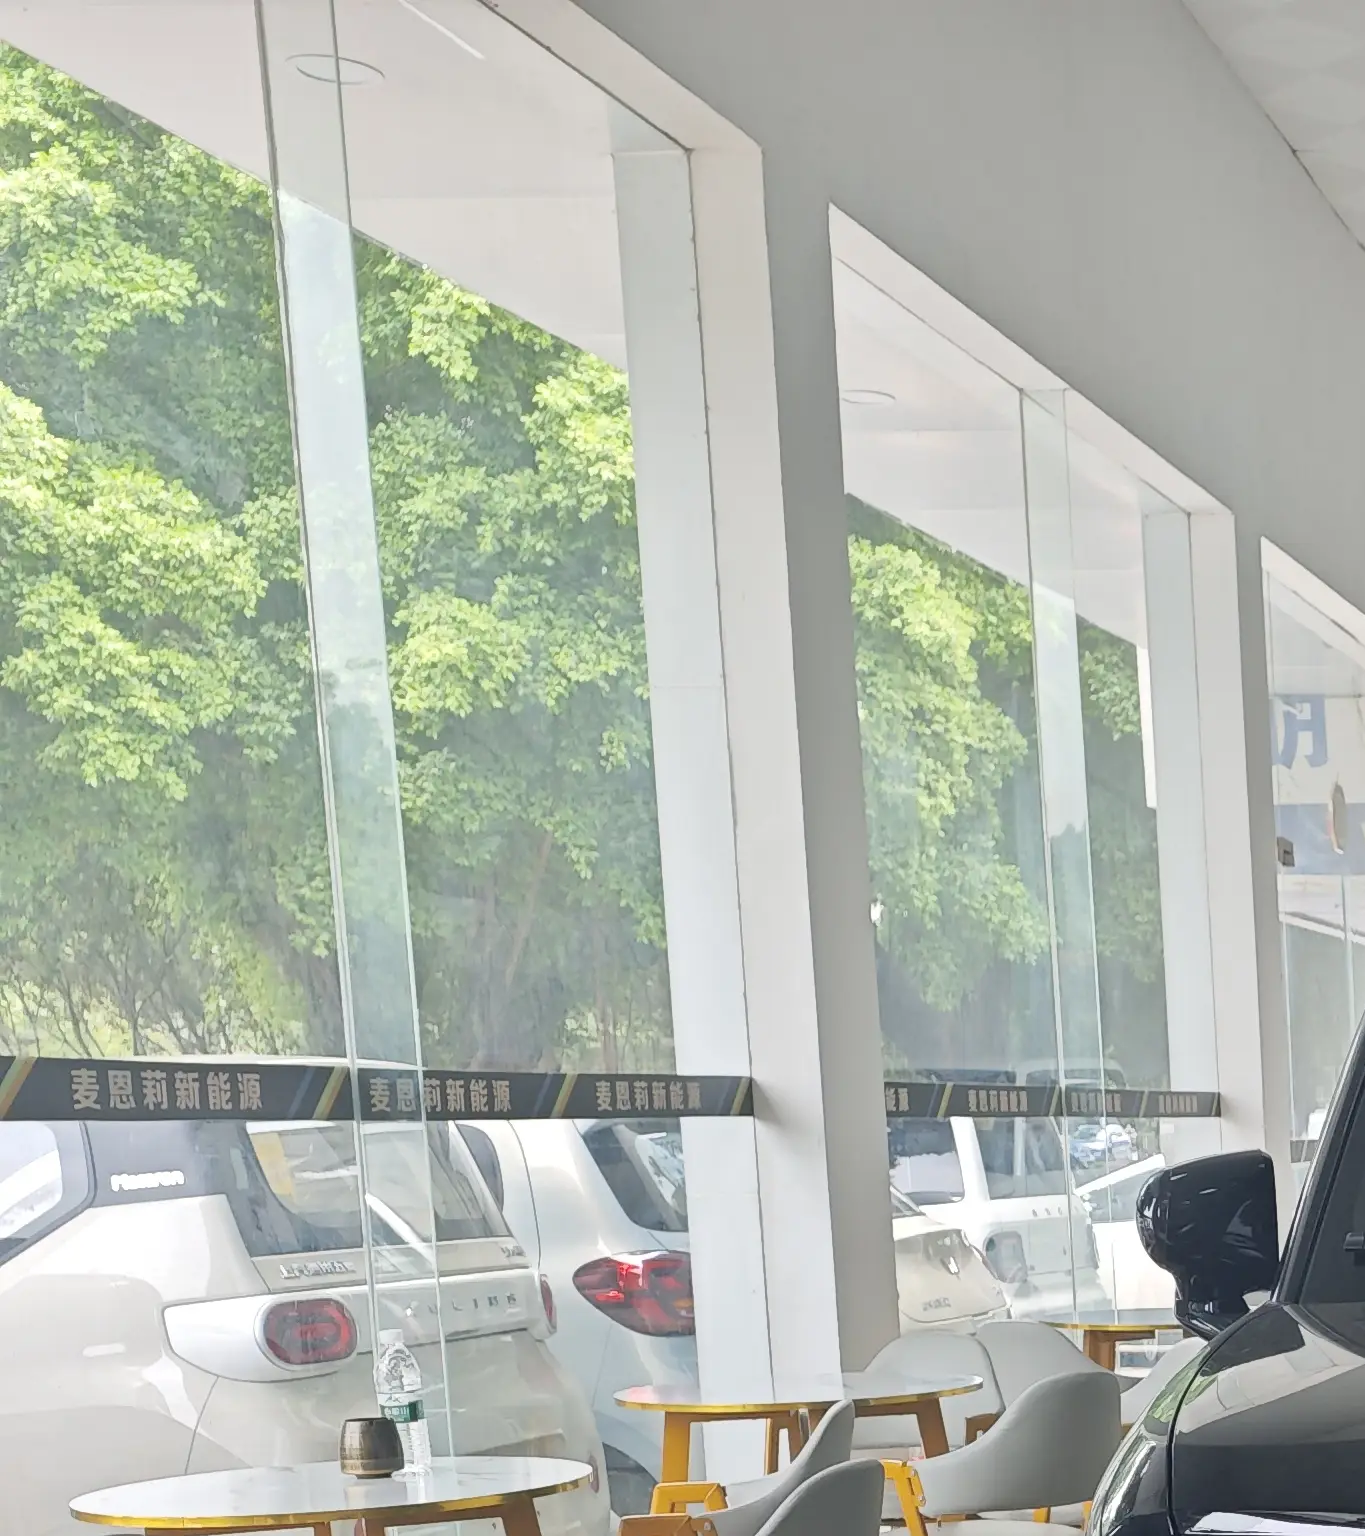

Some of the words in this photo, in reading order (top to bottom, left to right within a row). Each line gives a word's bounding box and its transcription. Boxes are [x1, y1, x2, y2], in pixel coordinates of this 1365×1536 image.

[70, 1067, 263, 1111] 麦恩莉新能源
[369, 1077, 512, 1113] 麦恩莉新能源
